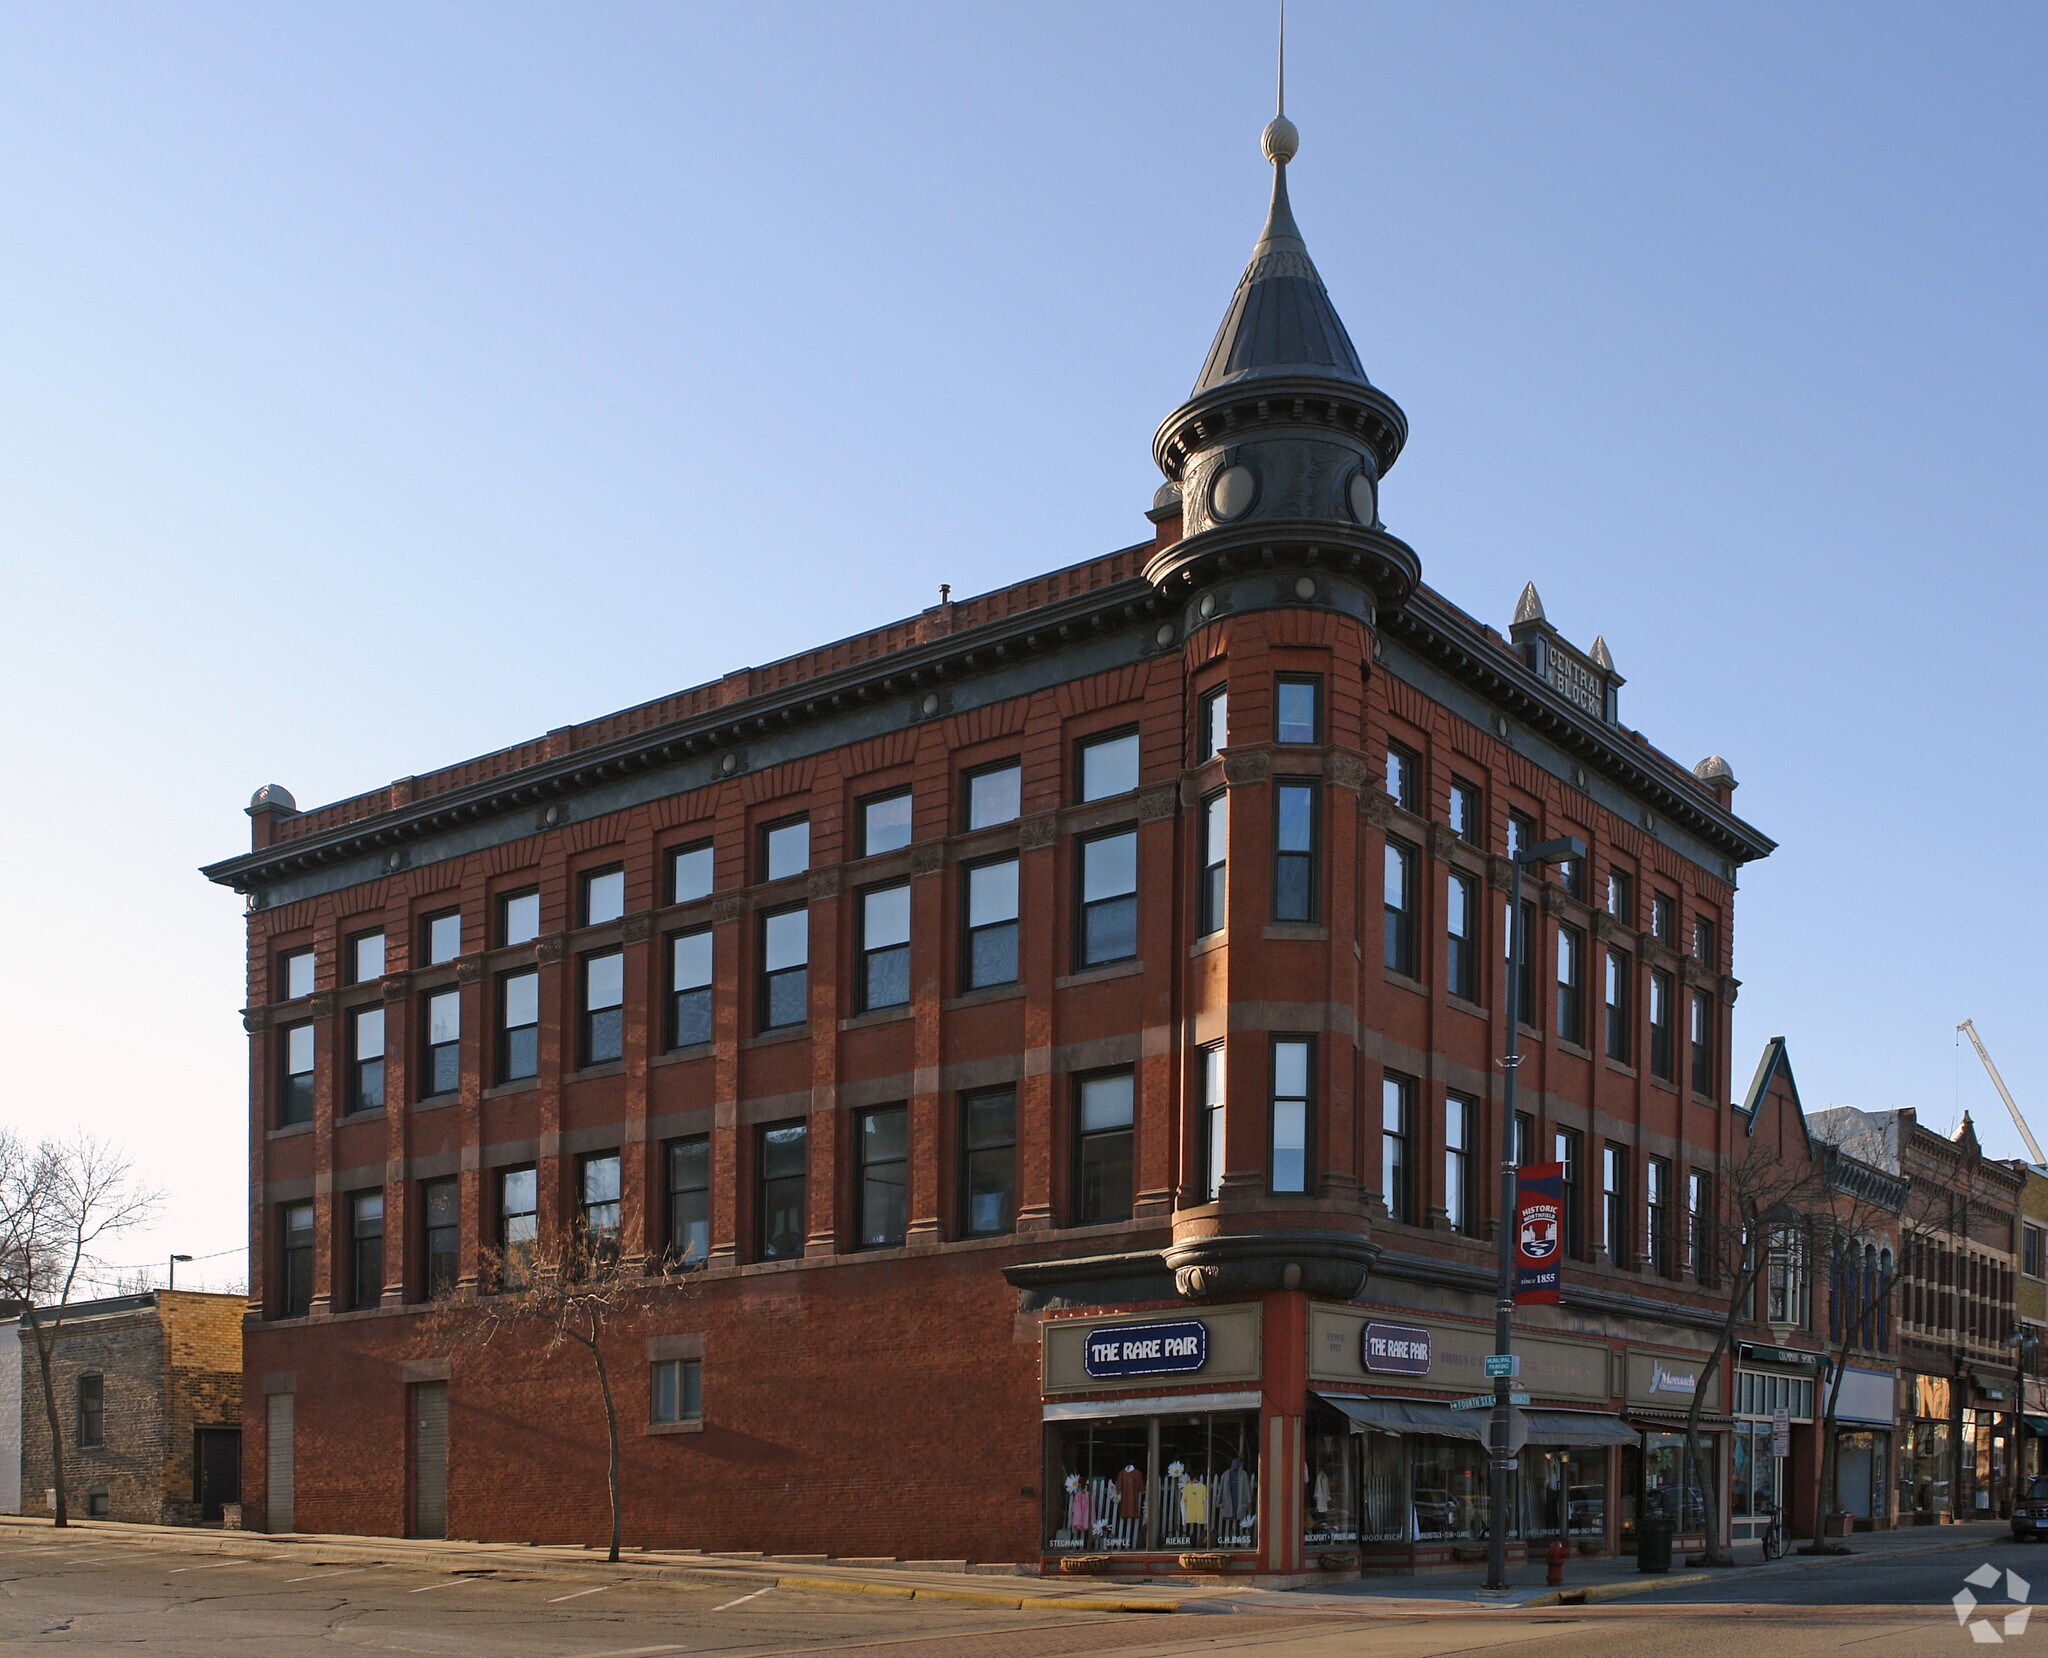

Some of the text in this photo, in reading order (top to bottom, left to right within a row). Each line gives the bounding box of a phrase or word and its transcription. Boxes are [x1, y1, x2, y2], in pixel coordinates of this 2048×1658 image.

[1549, 647, 1602, 699] CENTRAL
[1557, 672, 1596, 716] BLOCK
[1522, 1204, 1558, 1217] HISTORIC
[1523, 1212, 1556, 1222] NORTHFIELD
[1536, 1273, 1555, 1284] 1855
[1091, 1336, 1198, 1363] THE RARE PAIR
[1370, 1338, 1428, 1361] THE RARE PAIR
[1458, 1398, 1480, 1410] FOURTH
[1049, 1538, 1131, 1547] STEGMANN SIMPLE
[1165, 1536, 1252, 1545] RIEKER G.H.BASS
[1361, 1533, 1402, 1542] WOOLRICH
